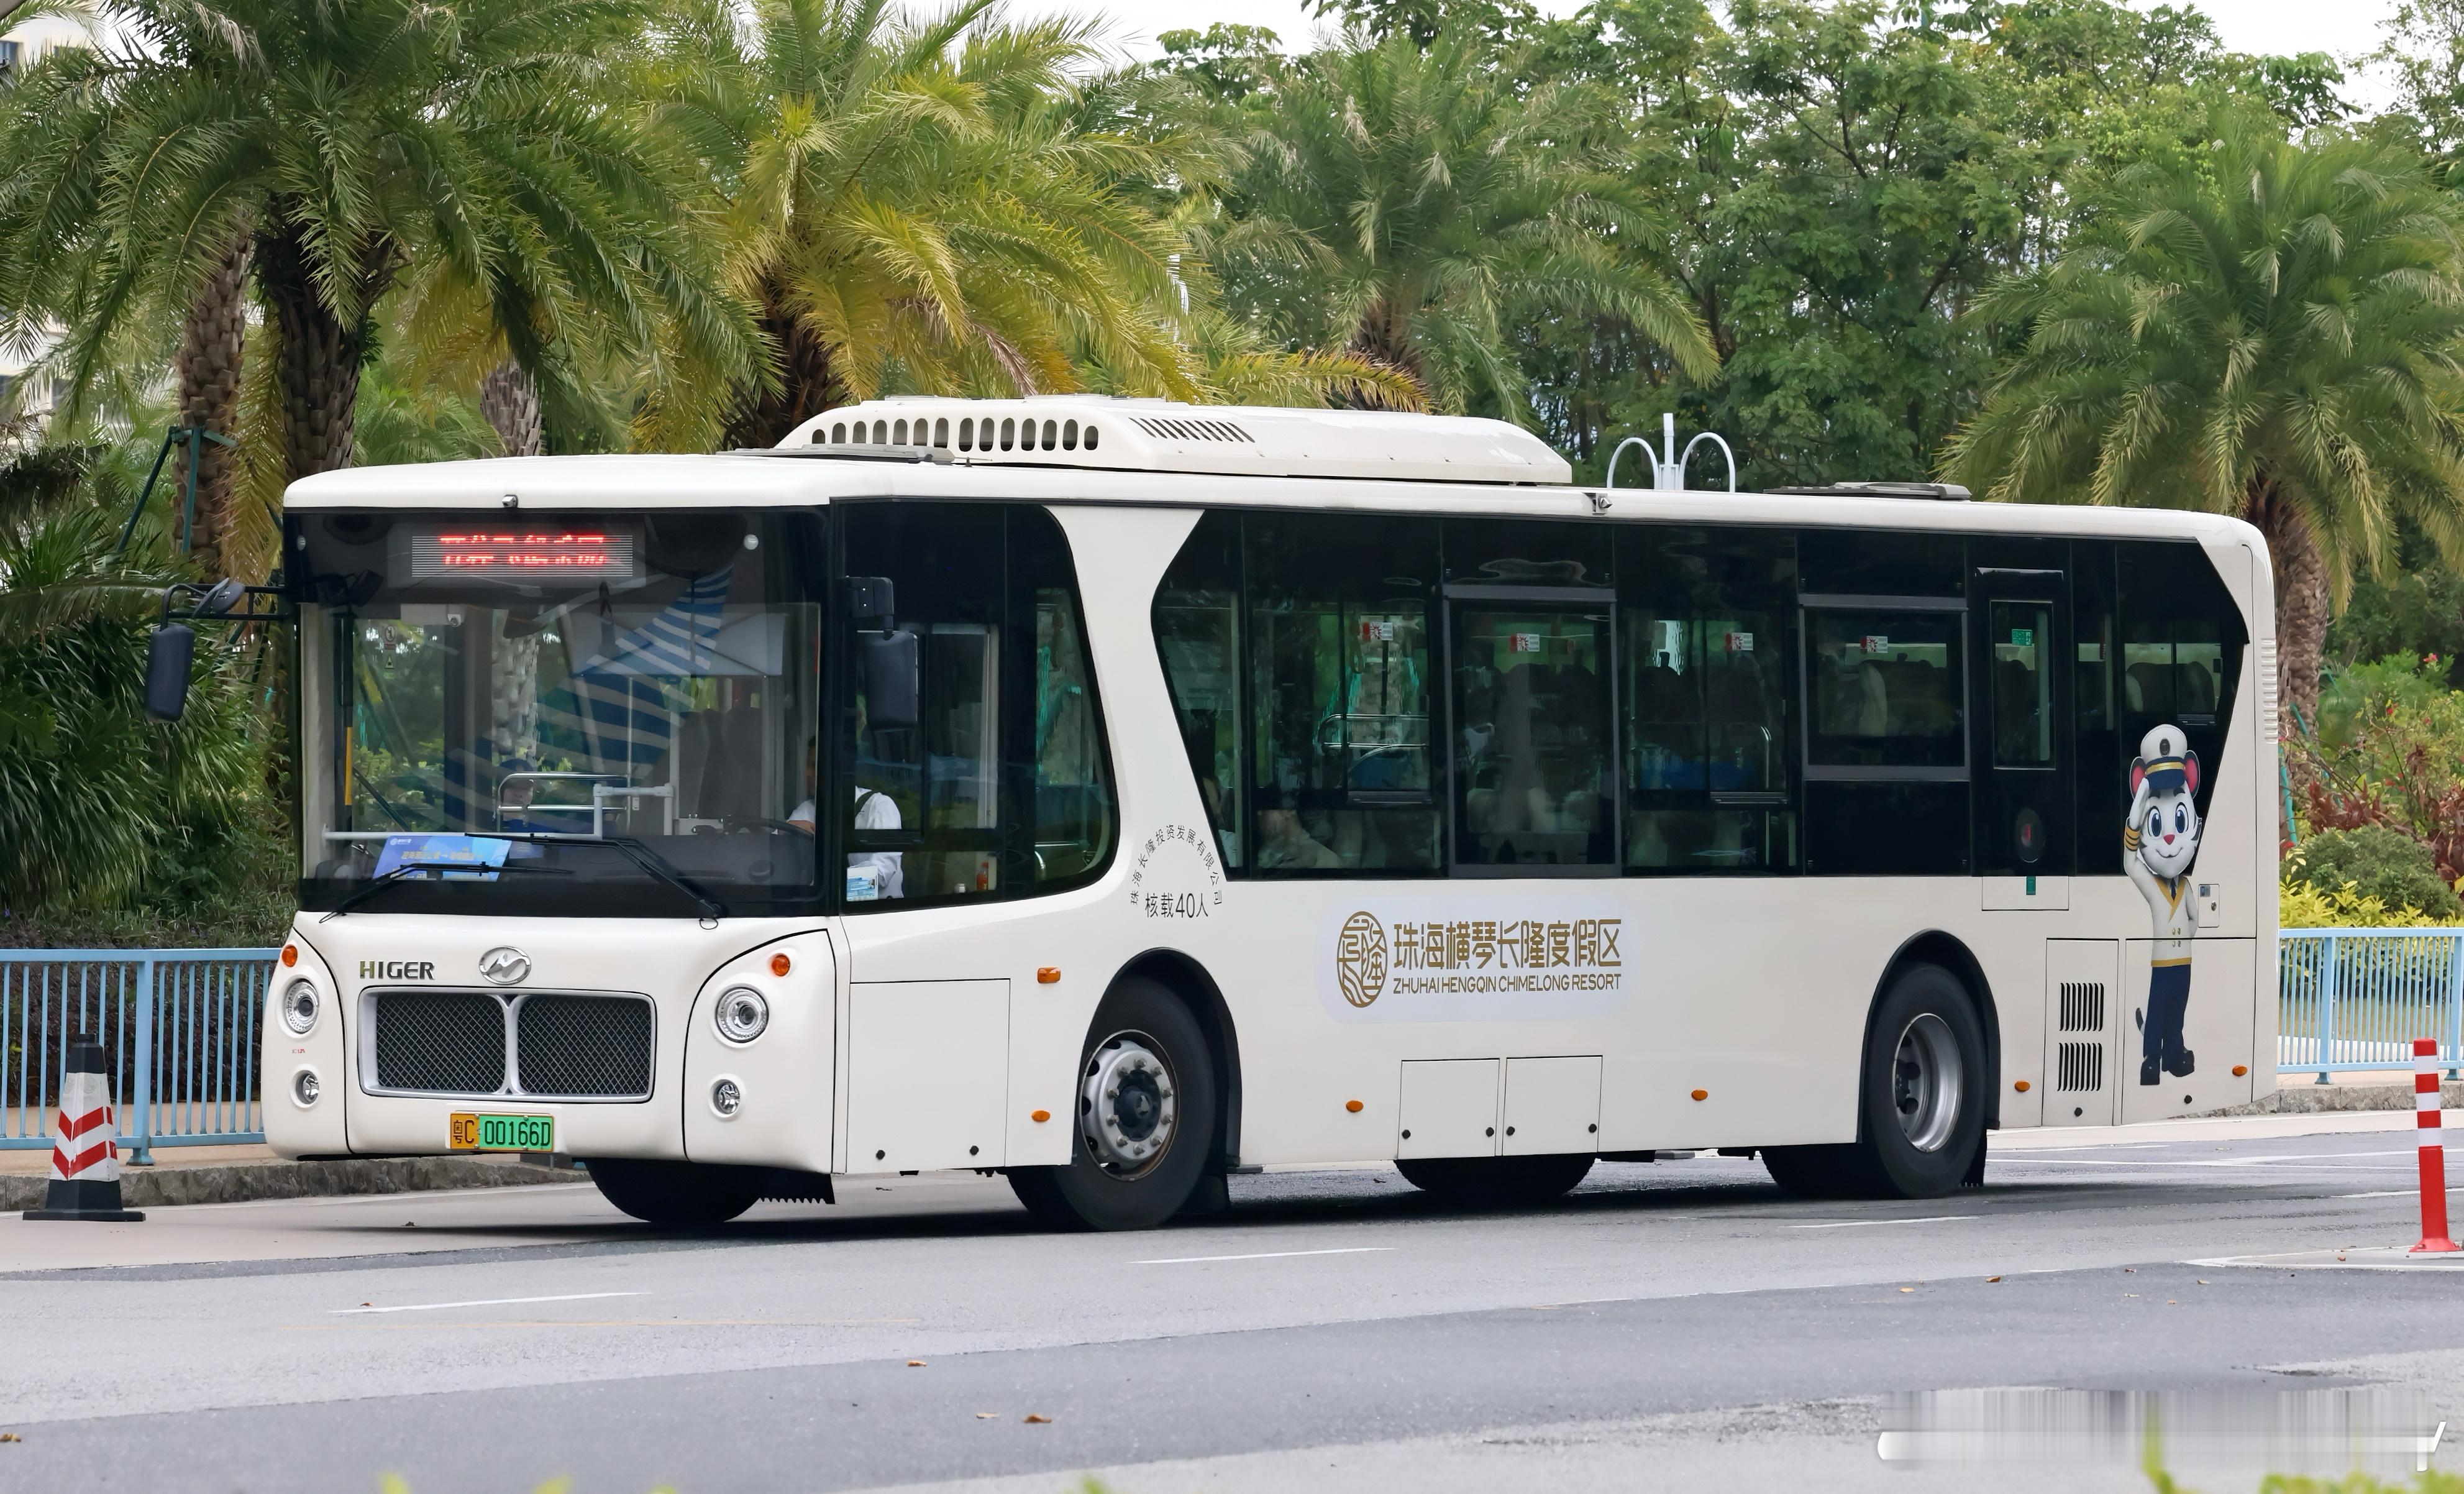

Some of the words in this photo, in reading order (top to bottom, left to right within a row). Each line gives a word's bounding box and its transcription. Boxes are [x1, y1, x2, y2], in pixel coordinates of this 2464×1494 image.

[1130, 824, 1222, 905] 珠海长隆投资发展有限公司
[1144, 892, 1208, 919] 核载40人
[1394, 919, 1622, 971] 珠海横琴长隆度假区
[360, 960, 435, 980] HIGER
[1393, 977, 1440, 994] ZHUHAI
[1441, 976, 1497, 994] HENGQIN
[1499, 974, 1571, 992] CHIMELONG
[1572, 973, 1622, 991] RESORT
